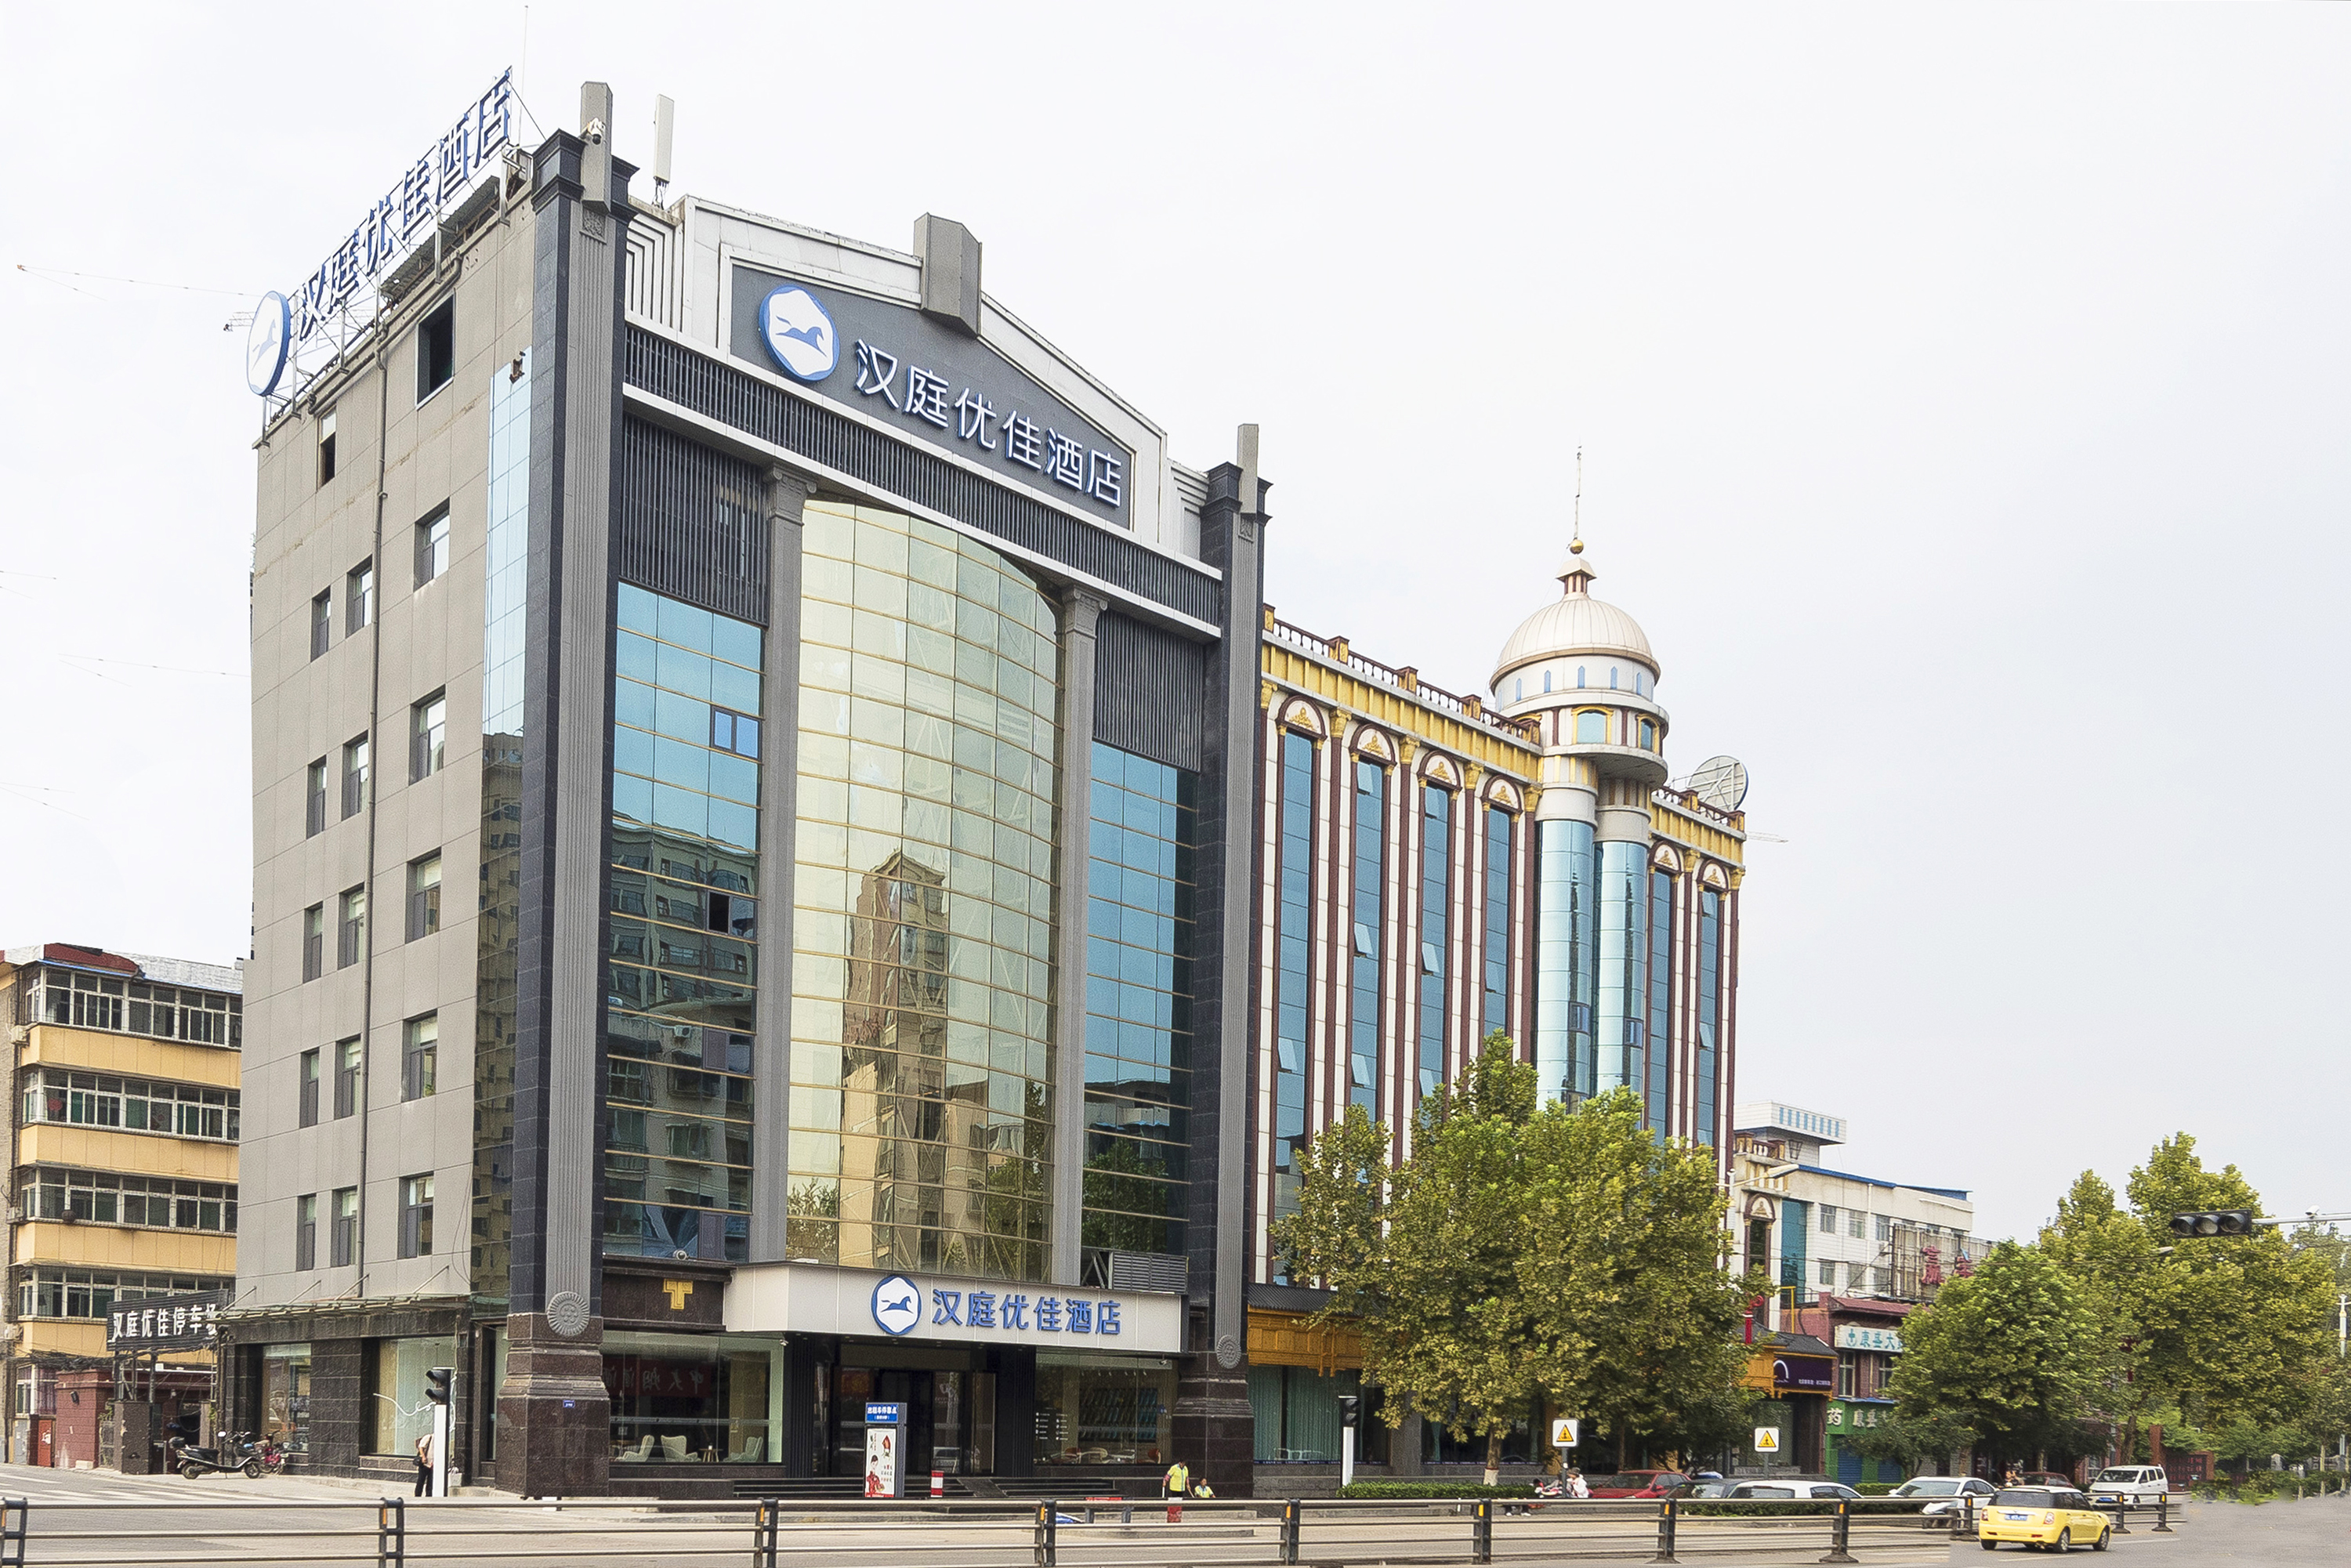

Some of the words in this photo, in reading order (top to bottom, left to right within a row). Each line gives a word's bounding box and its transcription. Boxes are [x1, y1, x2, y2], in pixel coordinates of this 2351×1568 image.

[299, 68, 512, 341] 汉庭优佳酒店
[854, 339, 1122, 508] 汉庭优佳酒店
[932, 1289, 1121, 1334] 汉庭优佳酒店
[1860, 1329, 1902, 1349] 康盛大
[1827, 1407, 1842, 1426] 药
